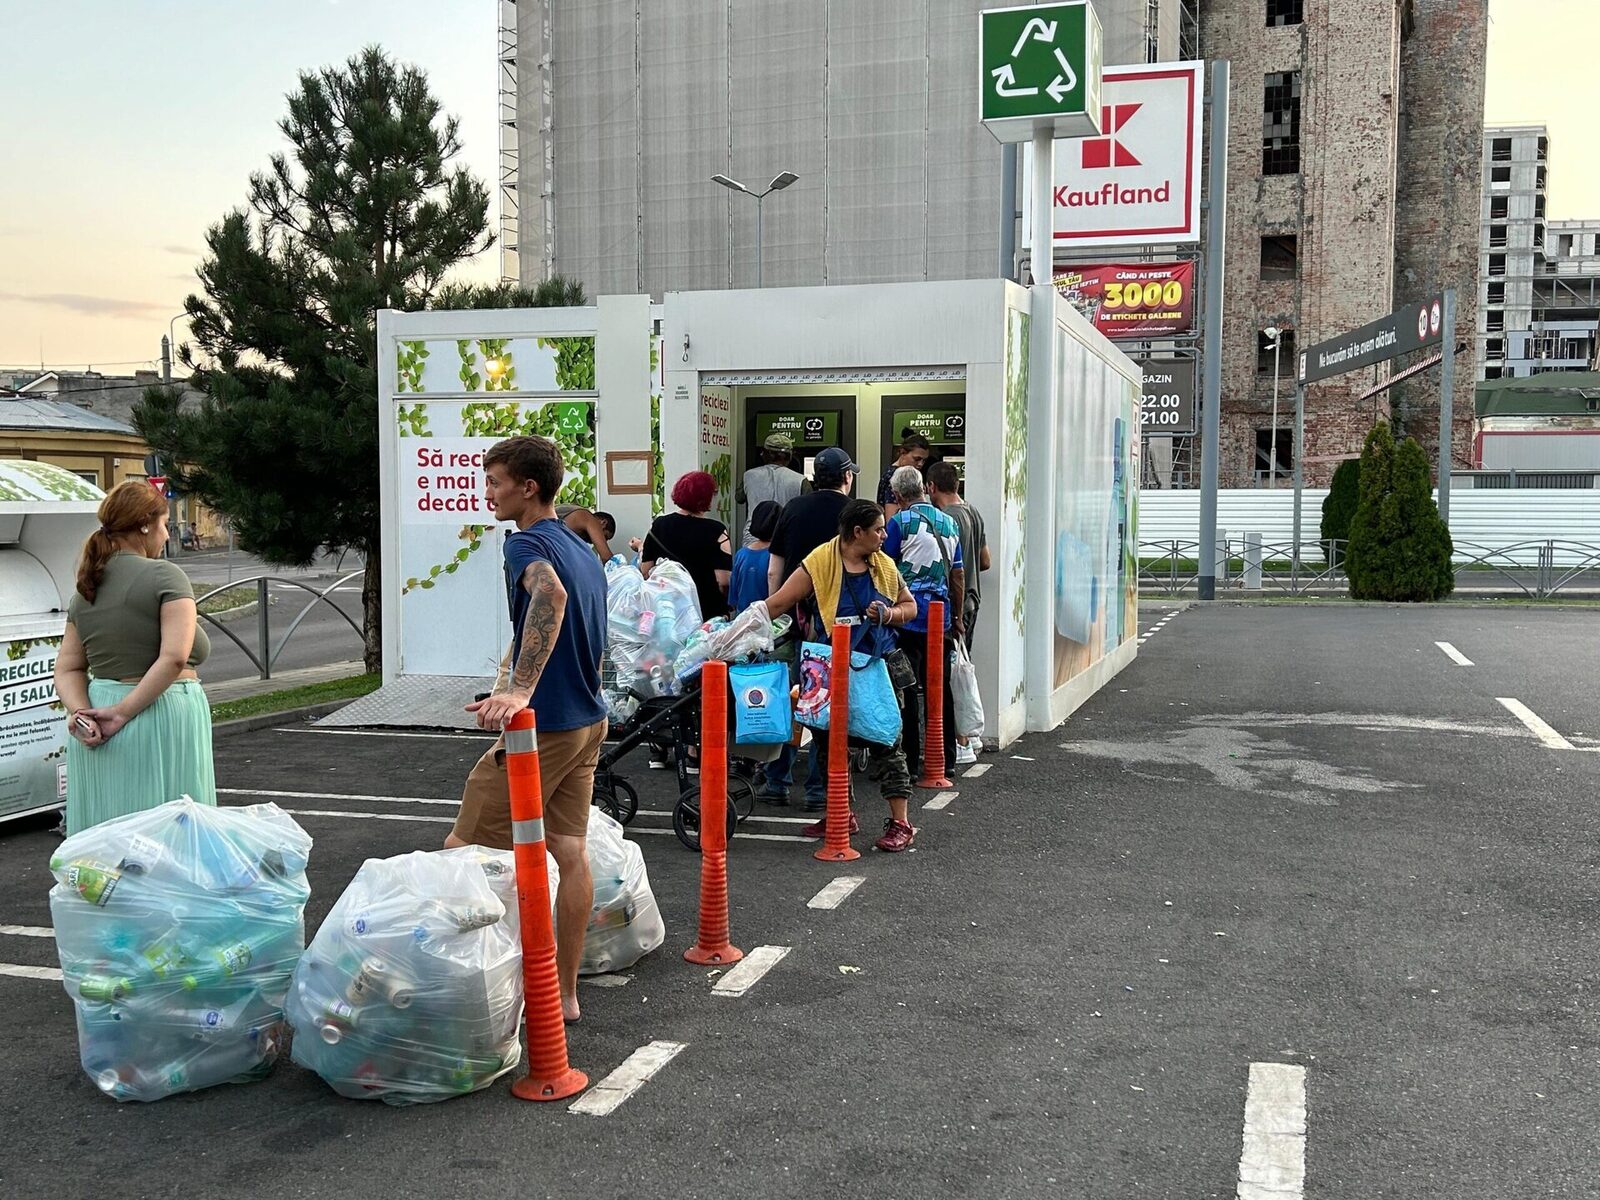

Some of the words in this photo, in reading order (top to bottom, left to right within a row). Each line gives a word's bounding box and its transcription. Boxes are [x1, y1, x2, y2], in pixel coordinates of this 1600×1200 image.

[1053, 180, 1170, 207] Kaufland
[1103, 281, 1182, 308] 3000
[1420, 314, 1427, 332] 10
[1319, 352, 1326, 368] Ne
[1354, 342, 1360, 357] te
[1141, 394, 1180, 408] 22.00
[909, 419, 941, 427] PENTRU
[1141, 411, 1179, 425] 21.00
[712, 432, 730, 448] crezi.
[919, 429, 931, 437] CU
[417, 447, 443, 468] Să
[417, 475, 430, 490] e
[436, 470, 476, 490] mai
[417, 491, 480, 512] decât
[0, 658, 56, 682] RECICLE
[3, 691, 16, 711] ȘI
[20, 684, 55, 704] SALV
